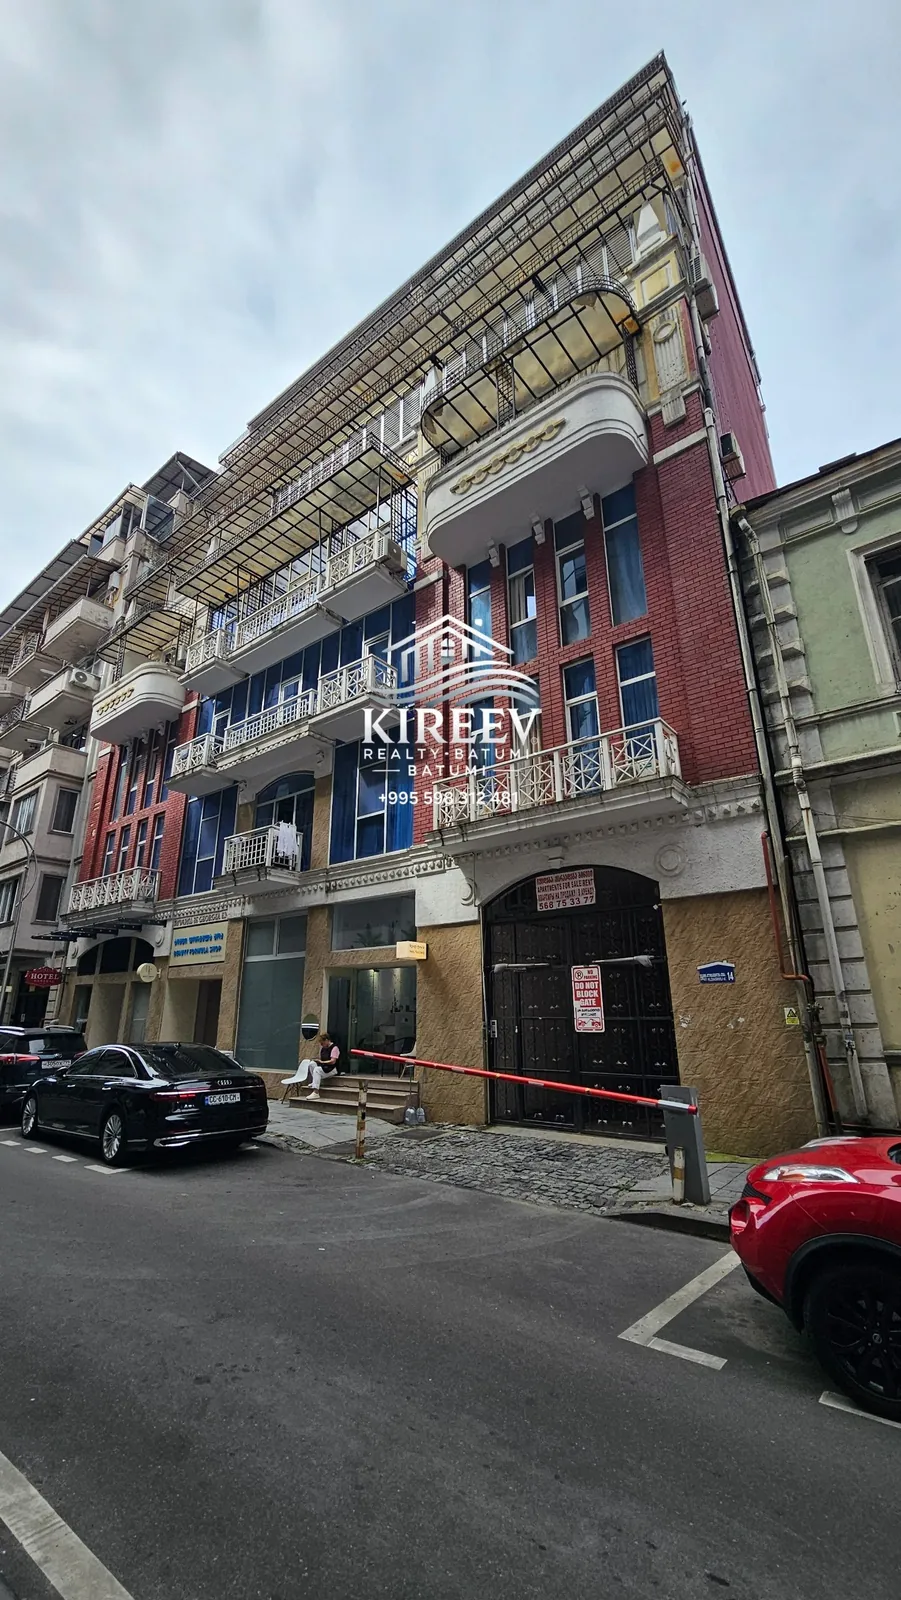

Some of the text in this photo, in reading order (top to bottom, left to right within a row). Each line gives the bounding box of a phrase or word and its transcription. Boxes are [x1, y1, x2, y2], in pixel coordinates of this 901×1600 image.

[537, 883, 562, 893] APARTMENTS
[562, 881, 570, 890] FOR
[571, 880, 582, 888] SALE
[556, 900, 567, 908] 75
[570, 897, 581, 906] 33
[583, 896, 594, 904] 77
[727, 971, 734, 981] 14
[575, 981, 599, 990] DO NOT
[576, 990, 599, 998] BLOCK
[580, 998, 597, 1006] GATE
